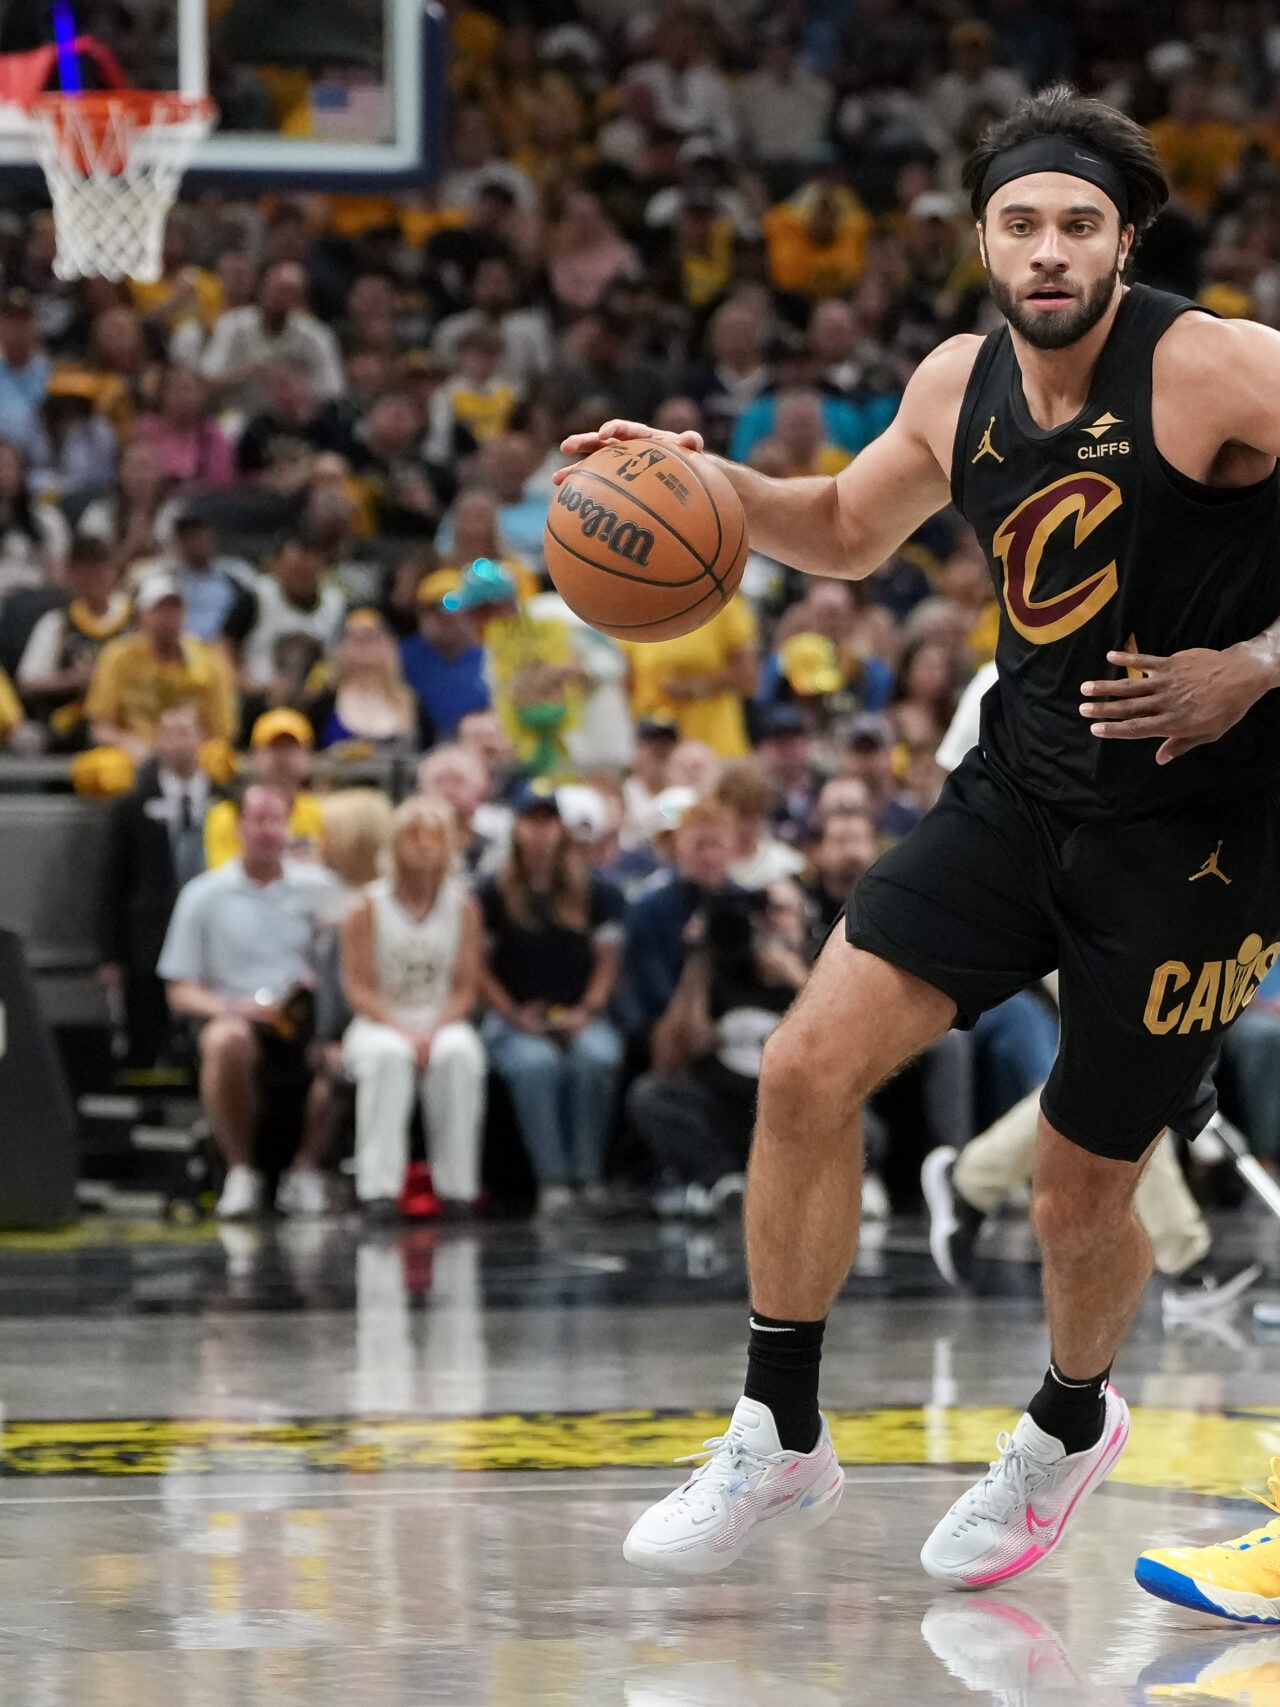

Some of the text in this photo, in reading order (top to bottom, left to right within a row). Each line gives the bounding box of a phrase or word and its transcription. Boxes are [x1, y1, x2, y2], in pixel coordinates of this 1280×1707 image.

[1077, 441, 1130, 460] CLIFFS
[558, 483, 655, 567] Wilson
[993, 471, 1123, 645] C
